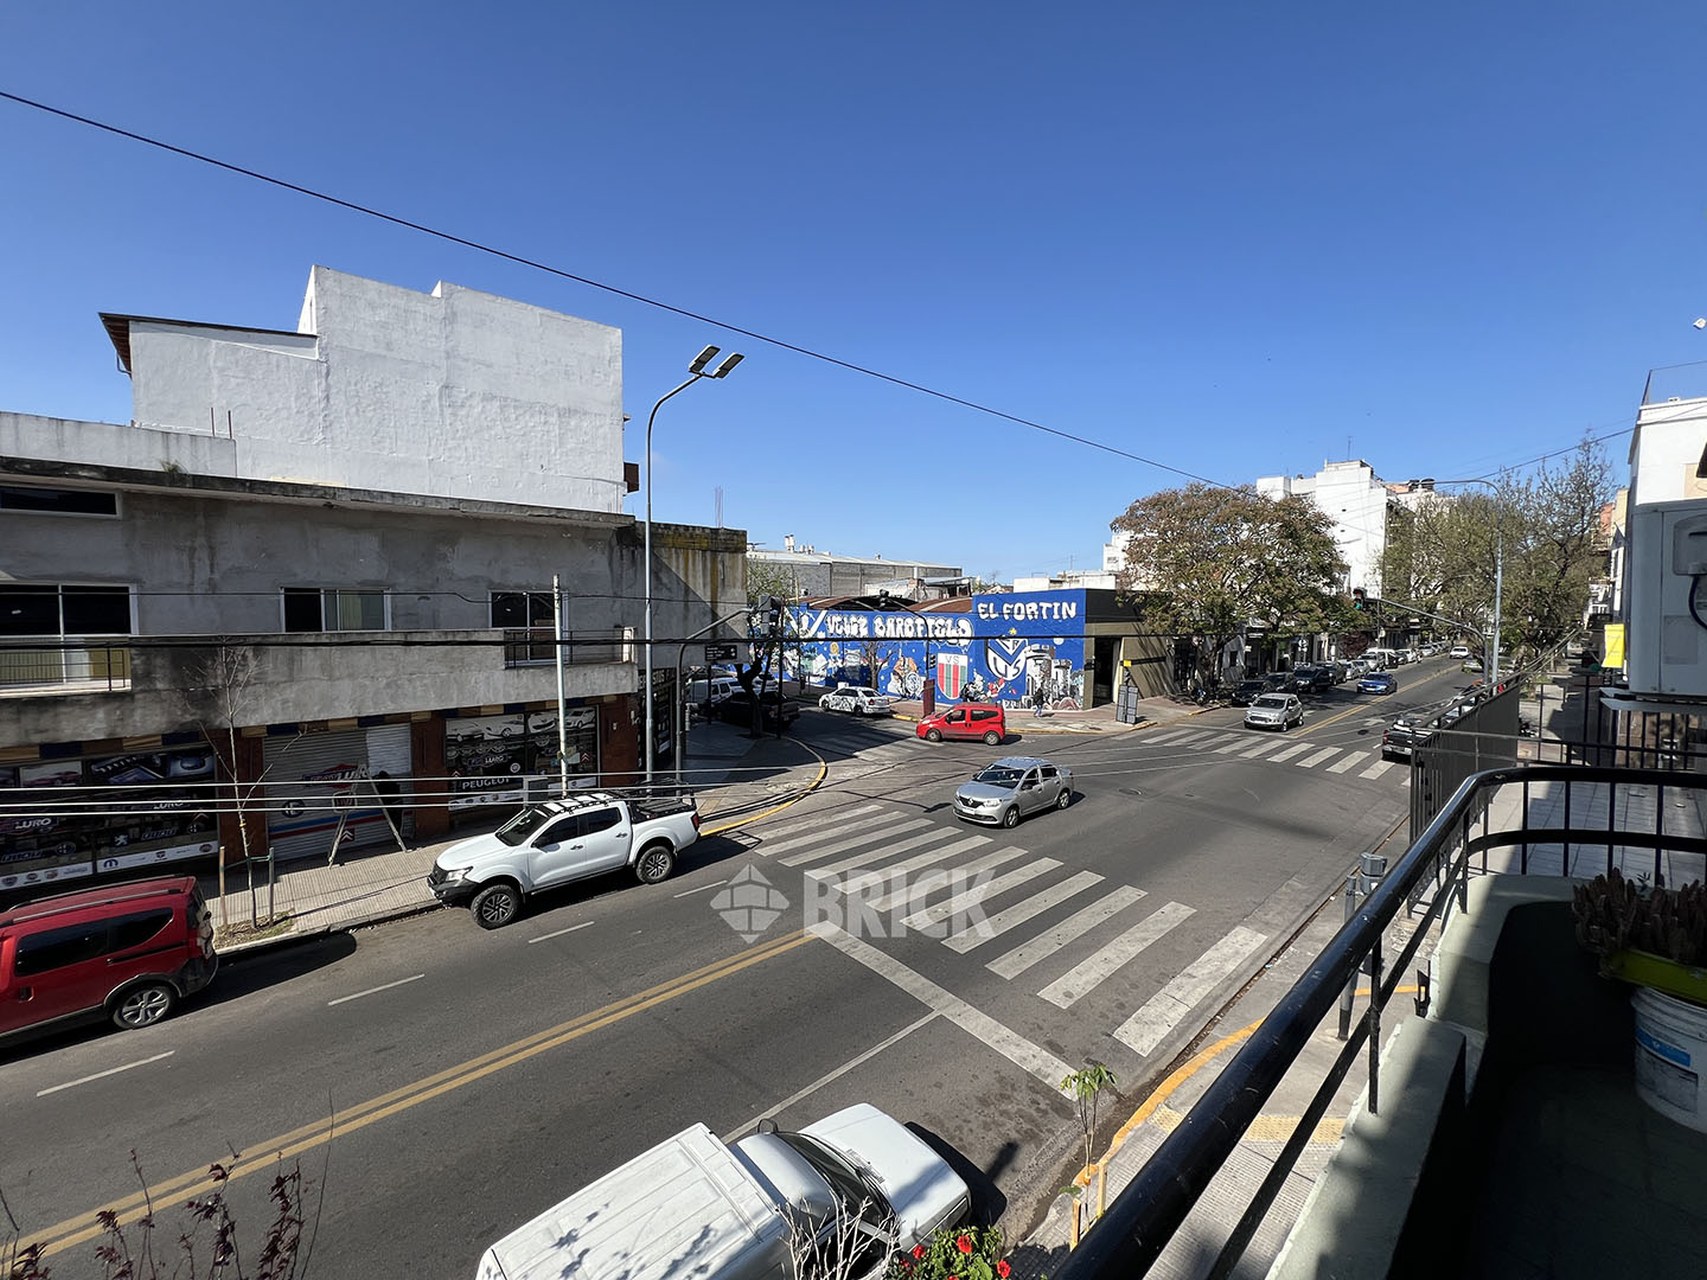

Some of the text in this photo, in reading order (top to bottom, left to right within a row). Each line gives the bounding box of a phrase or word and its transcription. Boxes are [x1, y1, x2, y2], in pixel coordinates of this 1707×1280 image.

[977, 601, 1077, 621] EL FORTIN
[462, 776, 510, 790] PEUGEOT
